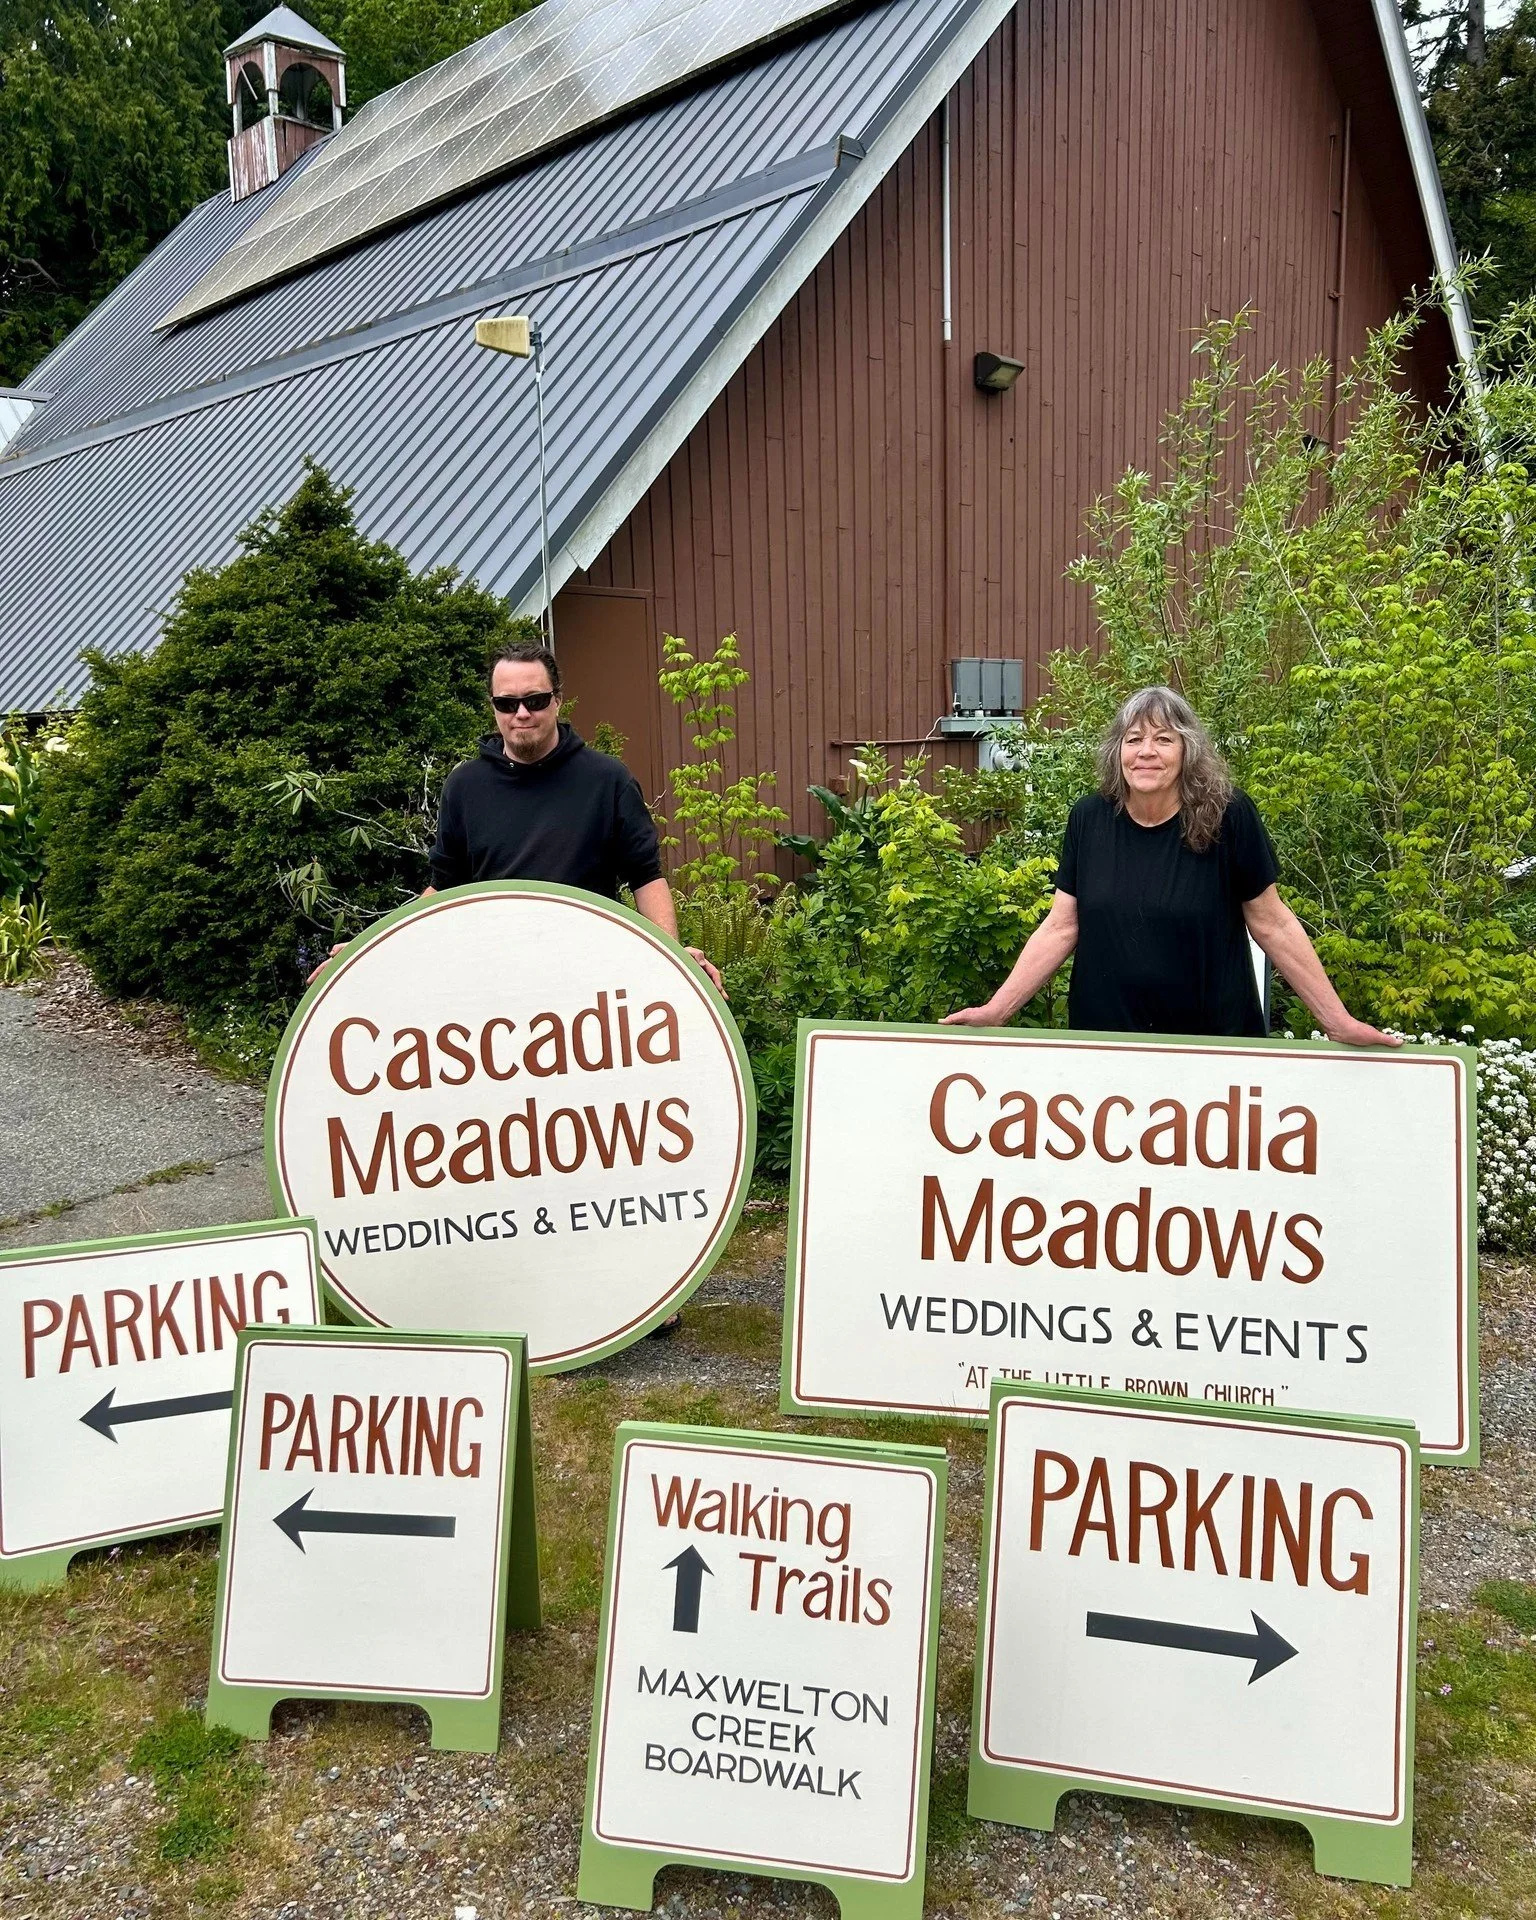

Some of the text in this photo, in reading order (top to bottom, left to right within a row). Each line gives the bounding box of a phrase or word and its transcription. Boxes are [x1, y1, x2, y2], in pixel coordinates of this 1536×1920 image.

[329, 988, 681, 1096] Cascadia
[327, 1096, 695, 1199] Meadows
[928, 1072, 1318, 1175] Cascadia
[325, 1188, 709, 1257] WEDDINGS & EVENTS
[920, 1174, 1325, 1285] Meadows
[24, 1270, 290, 1379] PARKING
[879, 1292, 1368, 1364] WEDDINGS & EVENTS
[259, 1392, 484, 1479] PARKING
[650, 1473, 852, 1563] Walking
[1029, 1448, 1374, 1596] PARKING
[738, 1551, 893, 1626] Trails
[637, 1665, 889, 1726] MAXWELTON
[691, 1712, 817, 1756] CREEK
[645, 1742, 862, 1800] BOARDWALK
